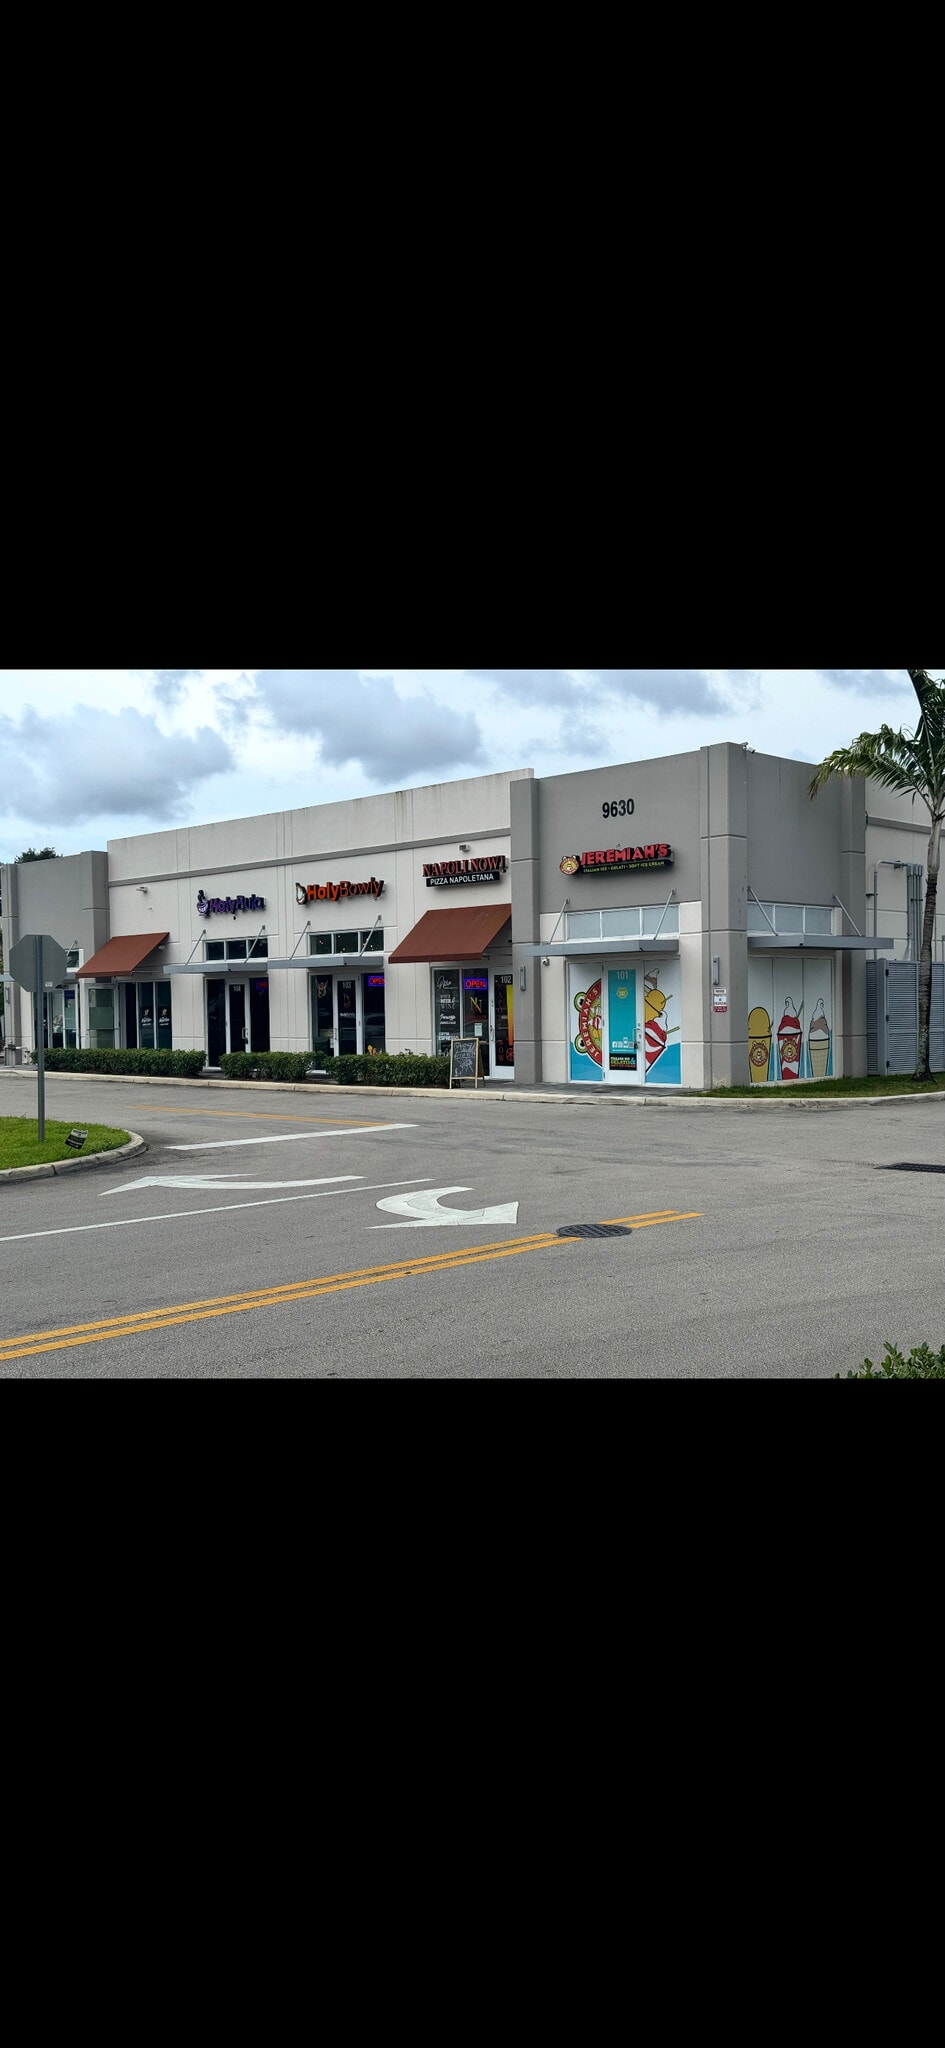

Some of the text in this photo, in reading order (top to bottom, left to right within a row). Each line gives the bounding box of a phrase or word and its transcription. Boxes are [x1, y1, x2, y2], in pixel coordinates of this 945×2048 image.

[602, 798, 635, 818] 9630
[581, 843, 671, 866] JEREMIAH'S
[423, 860, 469, 877] NAPOLI
[449, 873, 494, 884] NAPOLETANA
[307, 877, 385, 902] HolyBowly
[501, 976, 512, 984] 102
[616, 971, 629, 980] 101
[582, 988, 600, 1057] JEREMIAH'S
